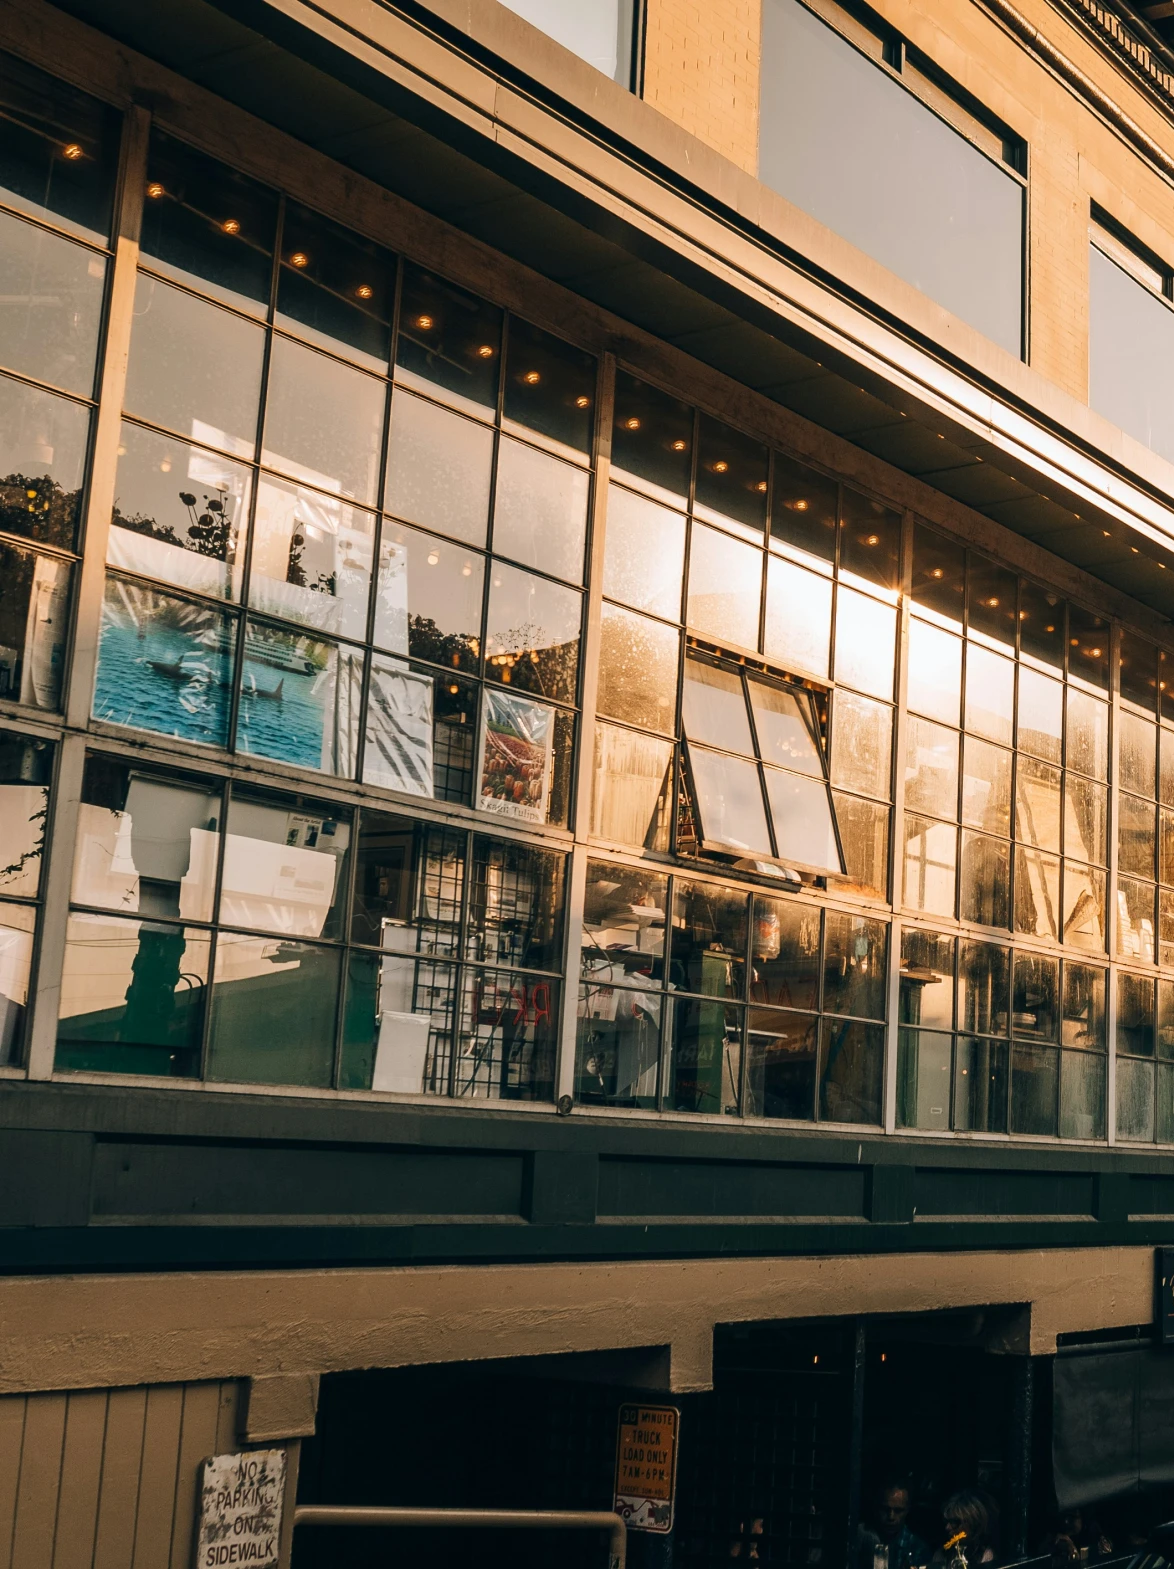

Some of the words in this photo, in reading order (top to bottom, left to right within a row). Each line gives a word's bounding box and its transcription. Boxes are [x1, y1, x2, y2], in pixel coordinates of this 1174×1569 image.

[512, 805, 540, 821] Tulips
[623, 1409, 637, 1421] 30
[641, 1411, 673, 1426] MINUTE
[632, 1429, 661, 1446] TRUCK
[623, 1447, 645, 1462] LOAD
[646, 1449, 668, 1464] ONLY
[238, 1461, 258, 1481] NO
[622, 1465, 666, 1482] 7AM-6PM
[216, 1486, 275, 1511] PARKING
[233, 1517, 254, 1536] ON
[206, 1539, 275, 1567] SIDEWALK
